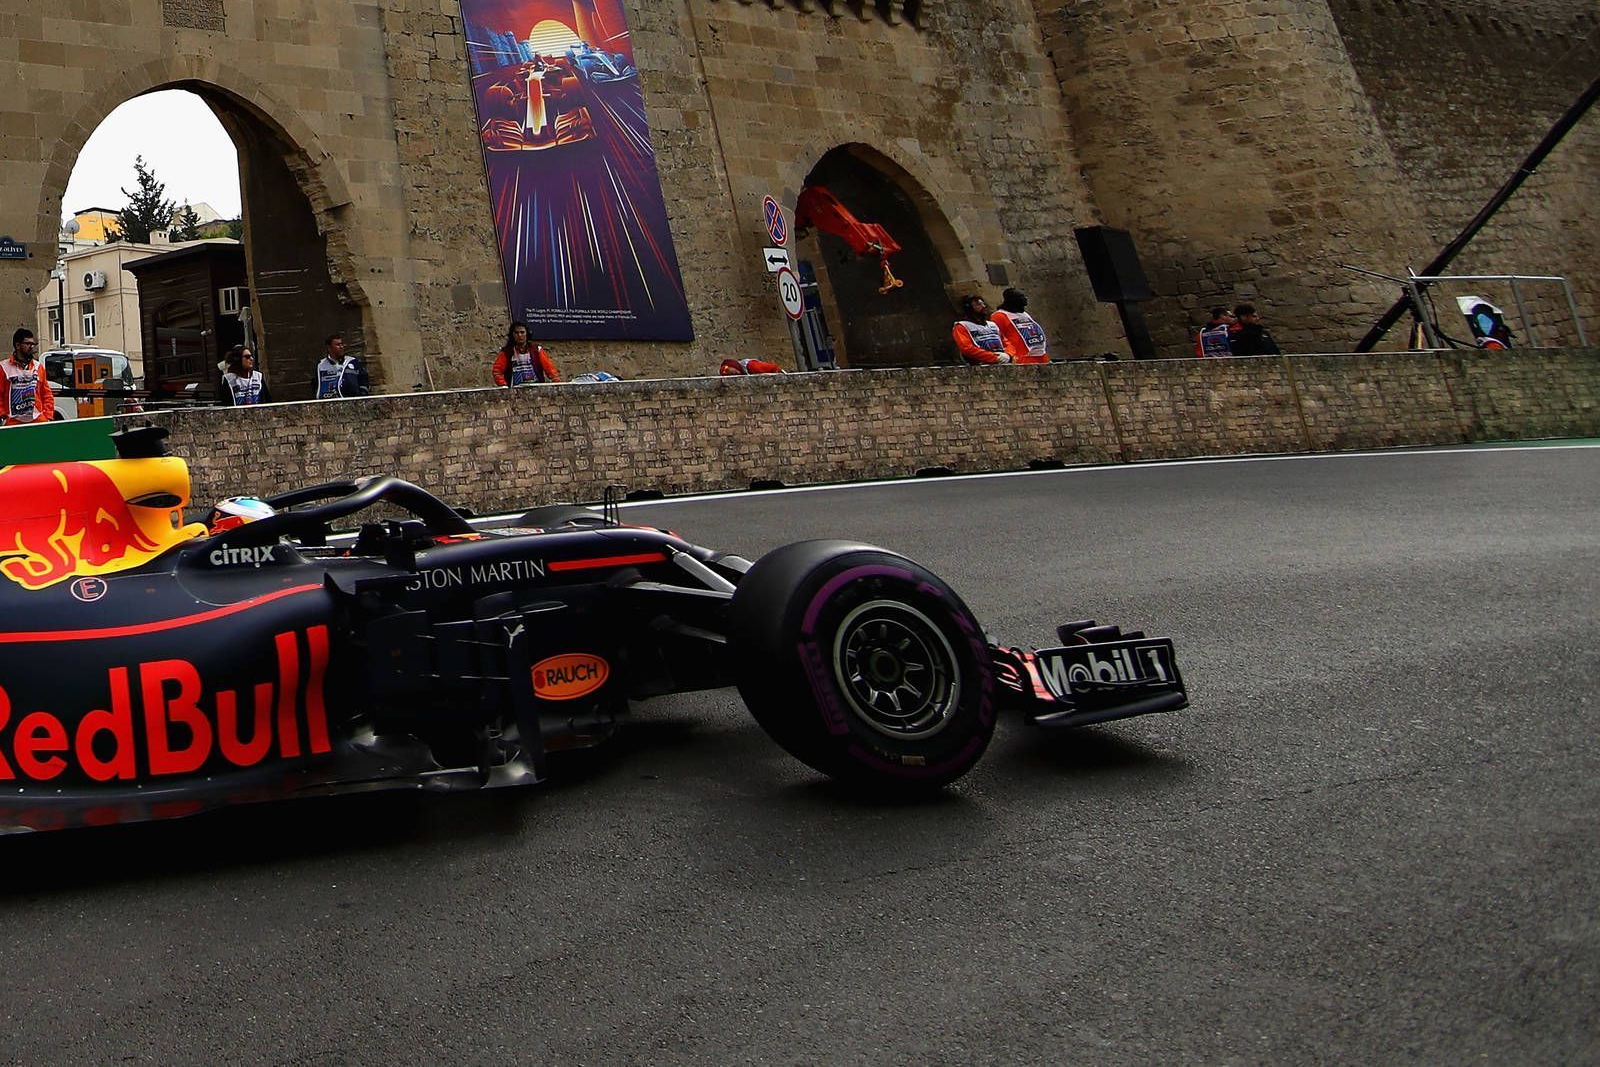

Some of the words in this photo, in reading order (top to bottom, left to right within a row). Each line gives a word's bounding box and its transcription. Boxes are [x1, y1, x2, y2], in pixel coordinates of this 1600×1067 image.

[782, 282, 798, 303] 20
[405, 566, 463, 591] STON
[471, 559, 546, 584] MARTIN
[79, 579, 100, 599] E
[545, 661, 599, 687] RAUCH
[1039, 648, 1138, 696] Mobil
[1147, 649, 1168, 682] 1
